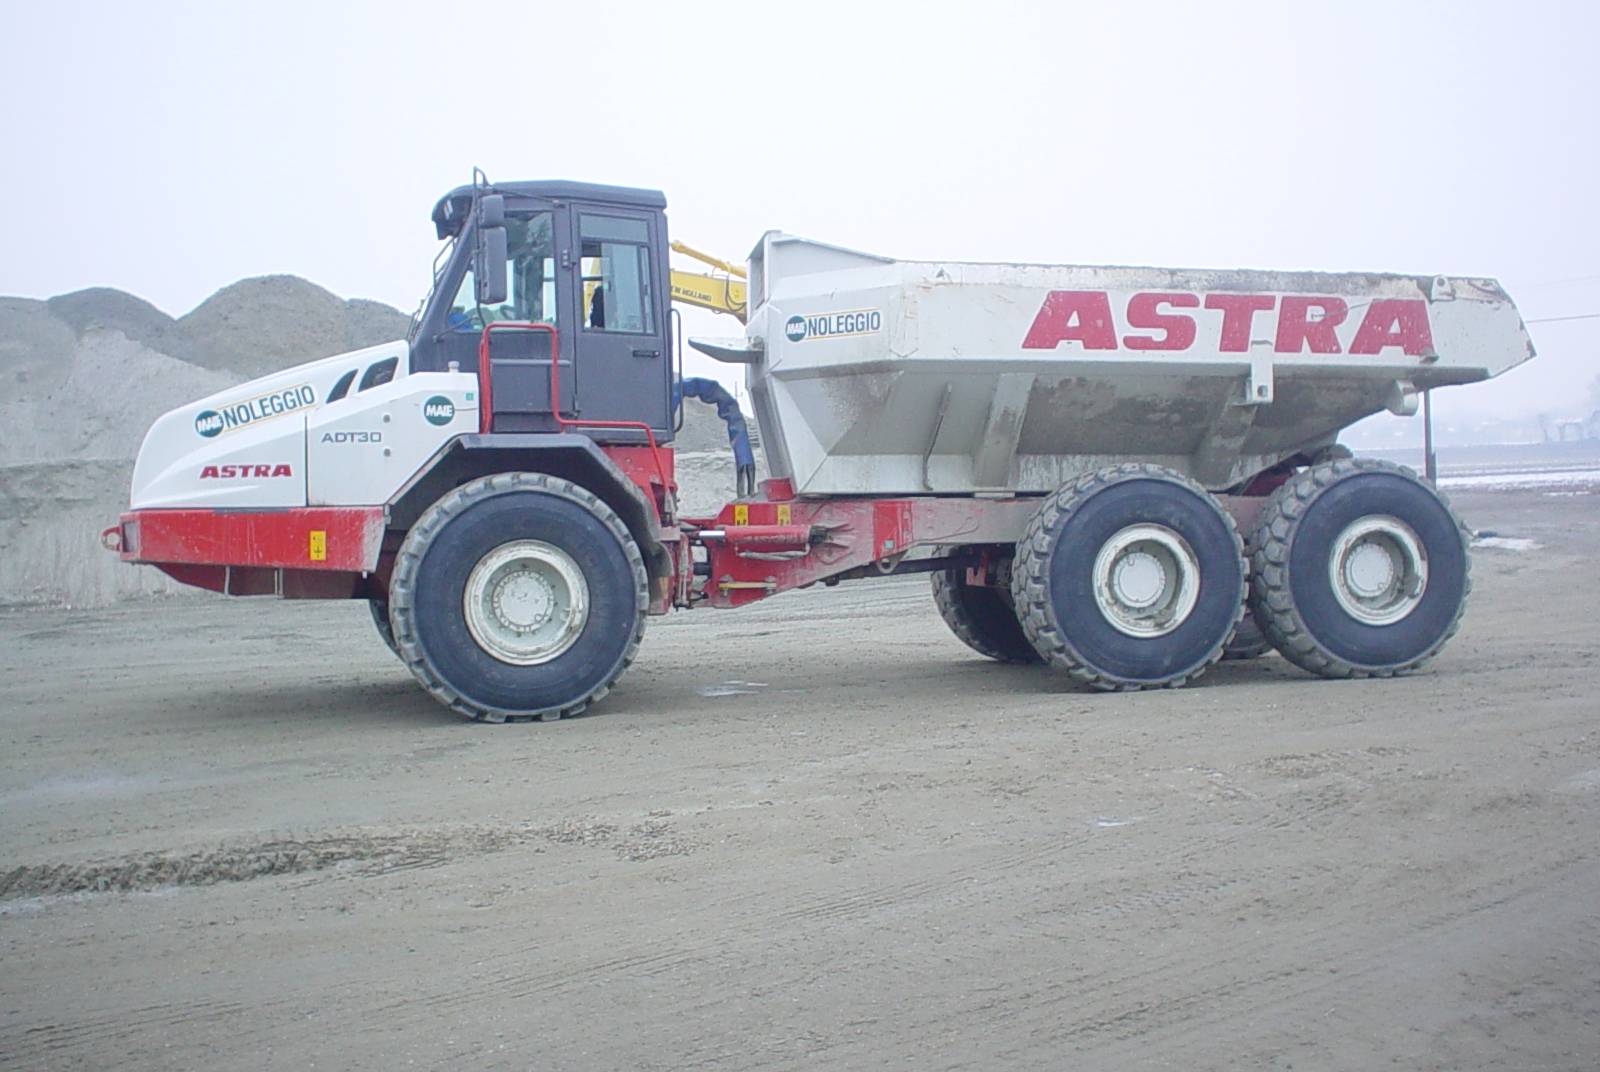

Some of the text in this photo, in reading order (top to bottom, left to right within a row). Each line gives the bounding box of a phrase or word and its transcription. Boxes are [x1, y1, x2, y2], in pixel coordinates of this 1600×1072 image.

[808, 311, 880, 336] NOLEGGIO
[1022, 291, 1437, 356] ASTRA
[223, 385, 315, 428] NOLEGGIO
[321, 432, 382, 443] ADT30
[200, 464, 292, 478] ASTRA
